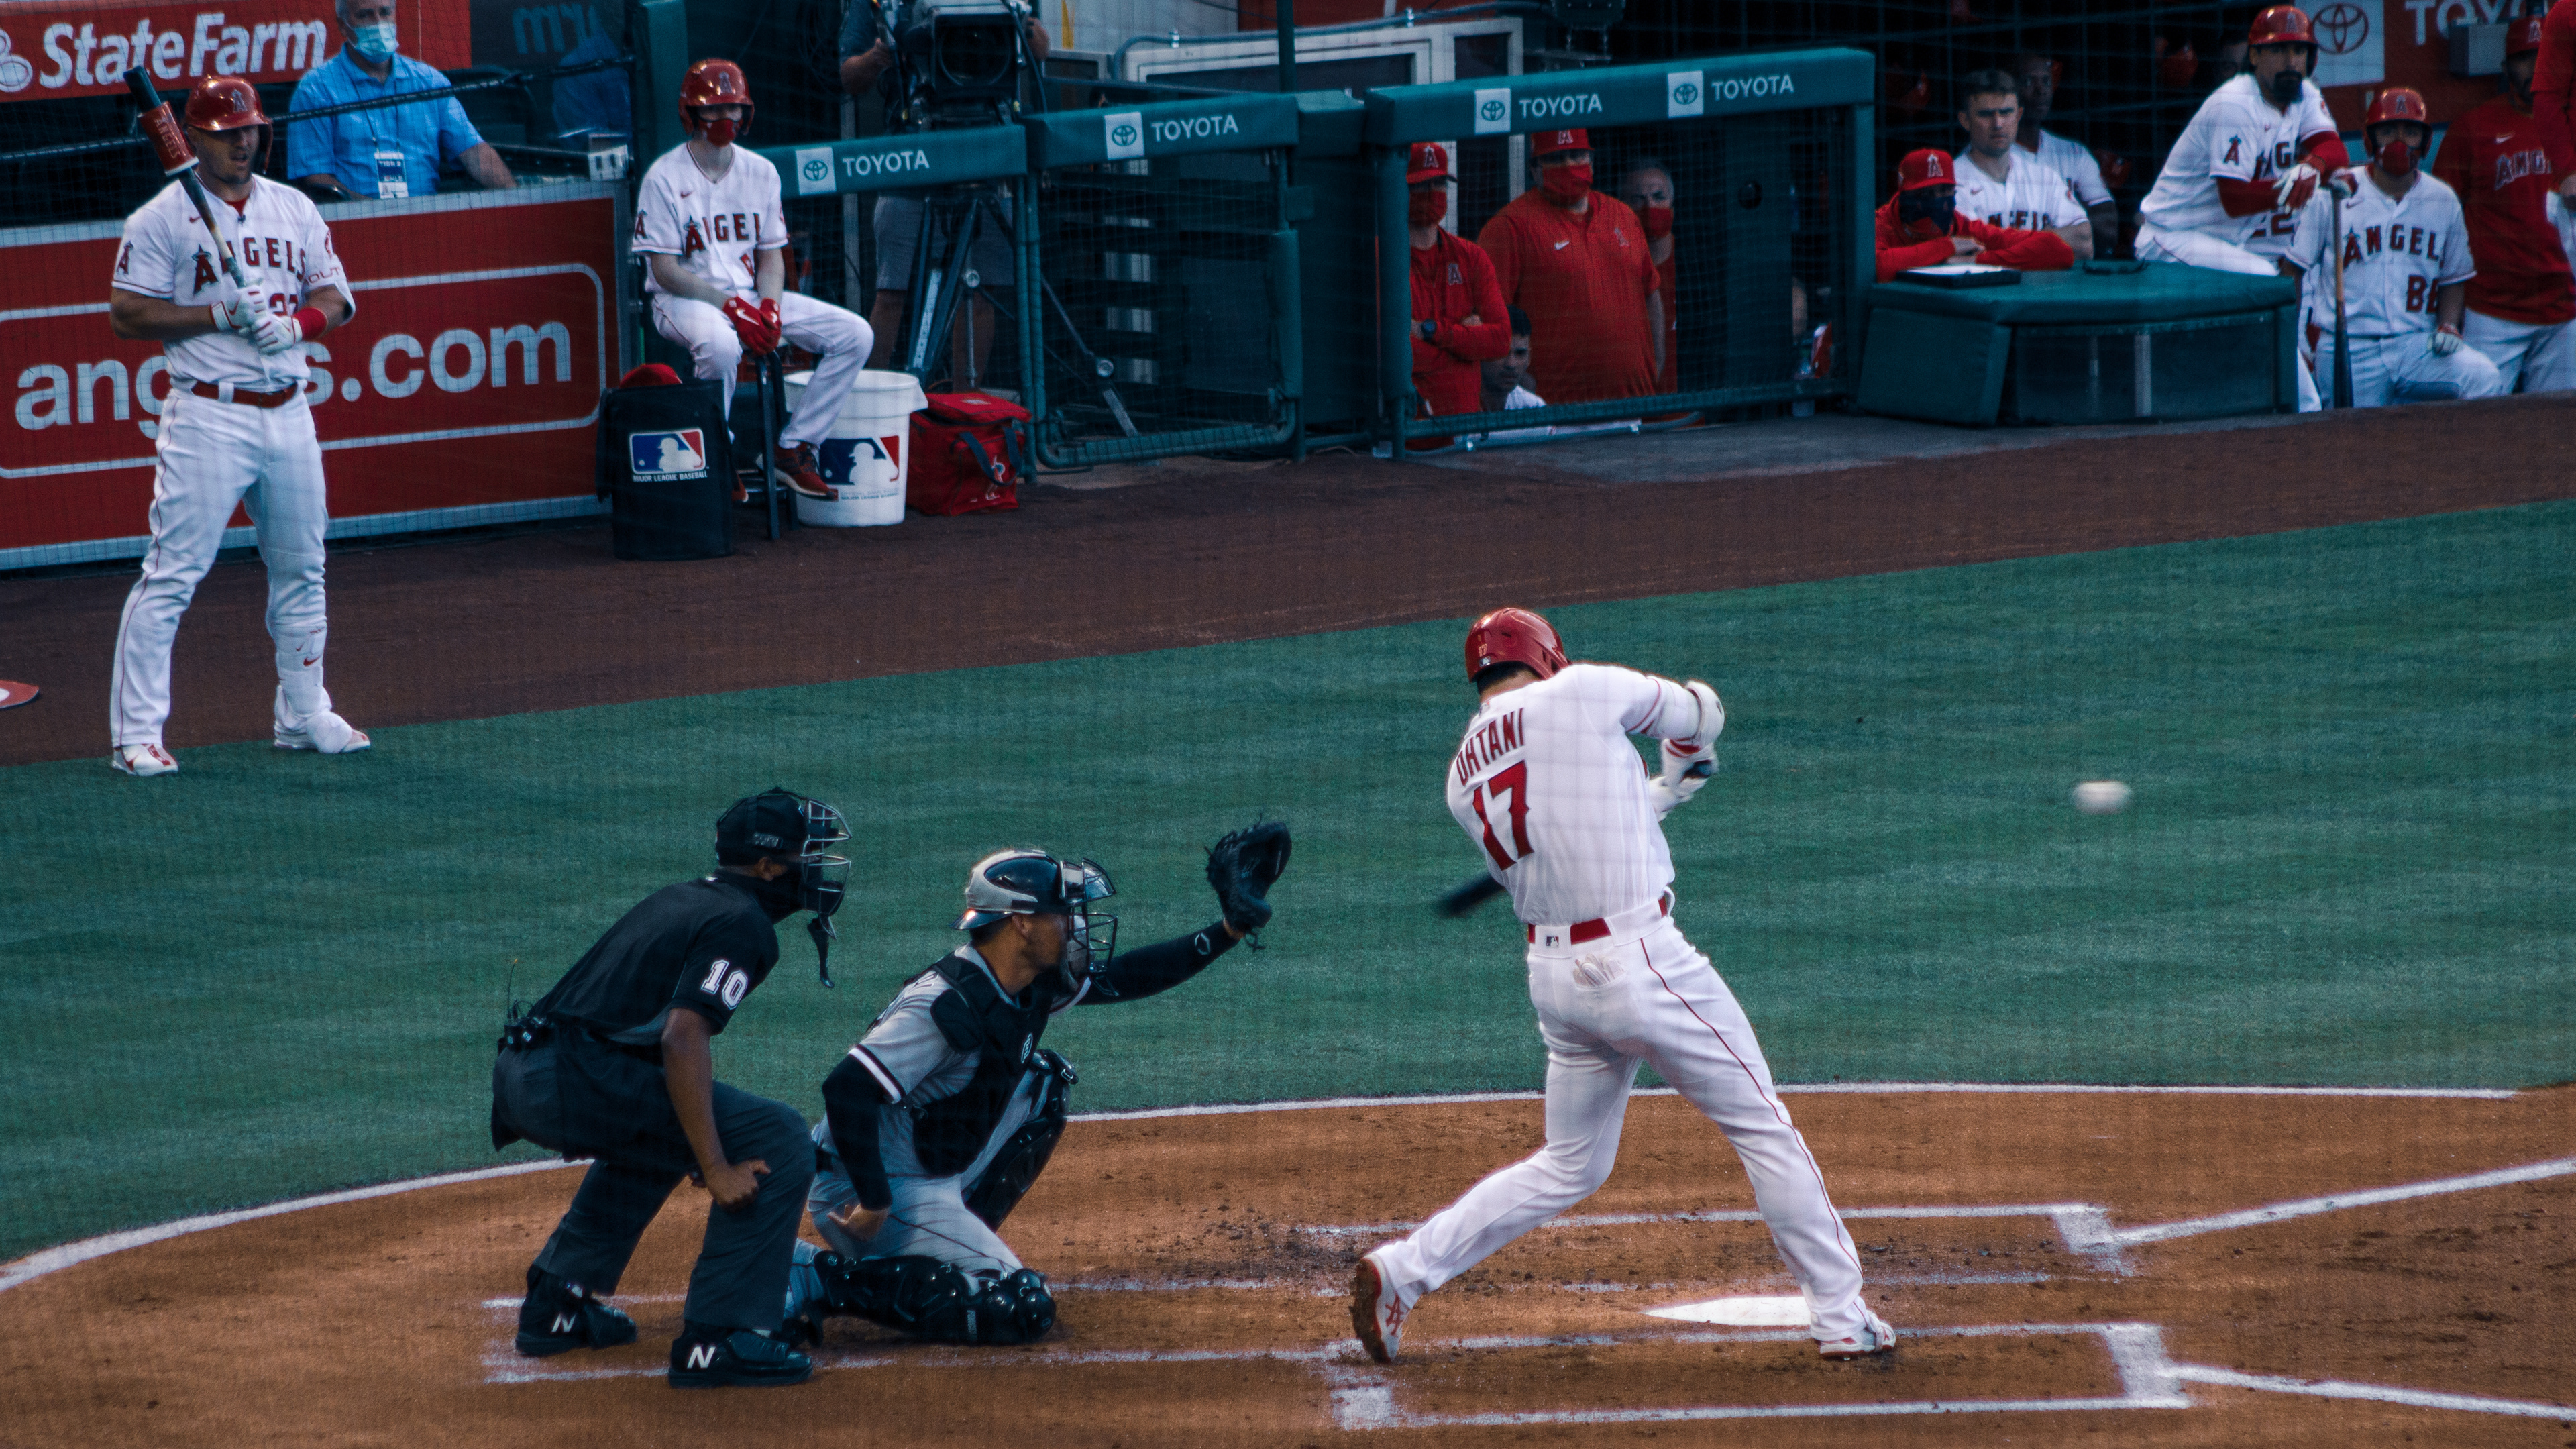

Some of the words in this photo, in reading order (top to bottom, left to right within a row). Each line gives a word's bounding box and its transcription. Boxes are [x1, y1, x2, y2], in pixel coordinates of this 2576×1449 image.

[39, 19, 184, 88] State
[189, 12, 327, 77] Farm
[1519, 93, 1603, 118] TOYOTA
[1711, 74, 1794, 101] TOYOTA
[1151, 114, 1238, 142] TOYOTA
[842, 149, 930, 177] TOYOTA
[2493, 149, 2552, 191] ANG
[2343, 223, 2444, 270] ANGEL
[14, 320, 572, 440] angs.com
[633, 474, 653, 483] MAJOR
[653, 473, 678, 482] LEAGUE
[679, 470, 708, 480] BASEBALL
[1456, 707, 1525, 786] OHTANI
[1472, 759, 1536, 871] 17
[700, 959, 749, 1010] 10
[686, 1345, 717, 1369] N
